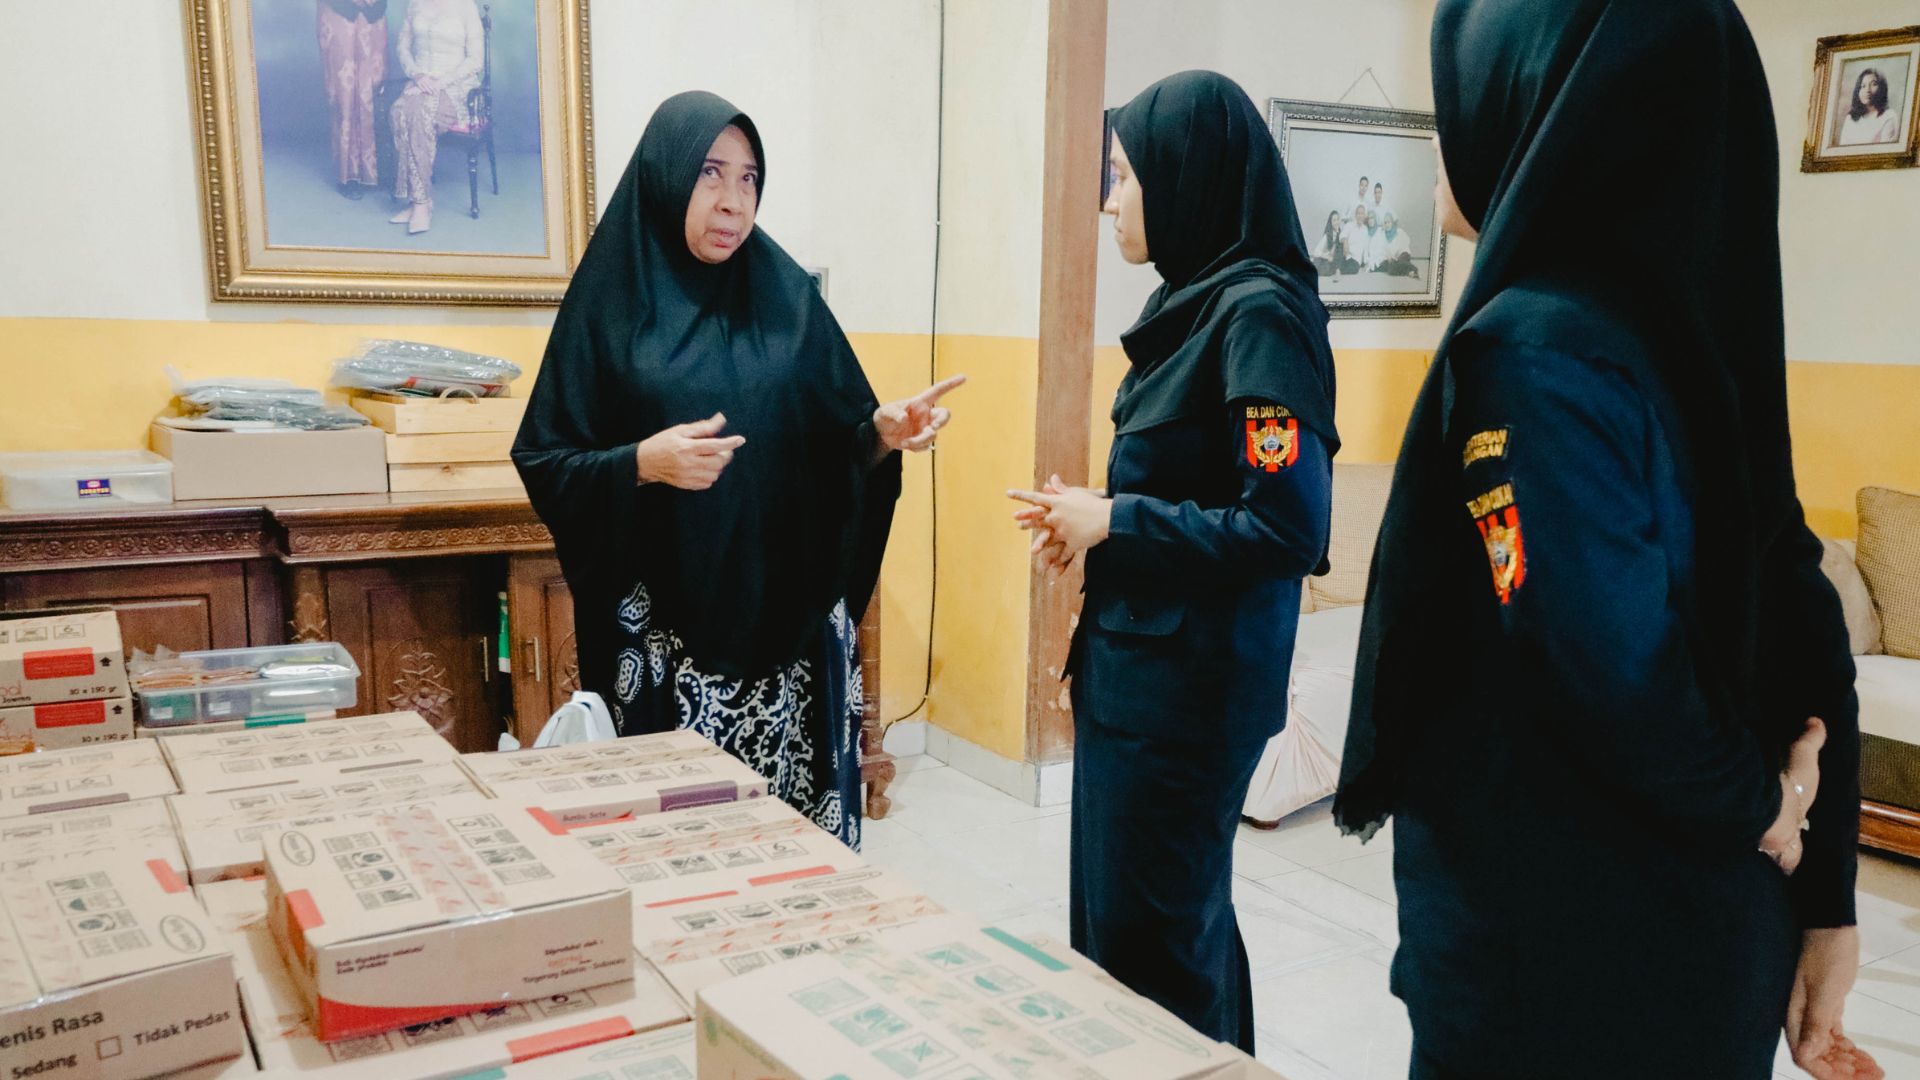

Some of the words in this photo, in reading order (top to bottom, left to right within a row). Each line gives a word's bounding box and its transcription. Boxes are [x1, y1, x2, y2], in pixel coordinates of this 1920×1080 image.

[1246, 406, 1258, 418] BEA
[1261, 406, 1274, 418] DAN
[0, 1025, 46, 1050] enis
[52, 1010, 104, 1035] Rasa
[133, 1023, 181, 1046] Tidak
[185, 1010, 231, 1032] Pedas
[12, 1053, 78, 1080] Sedang
